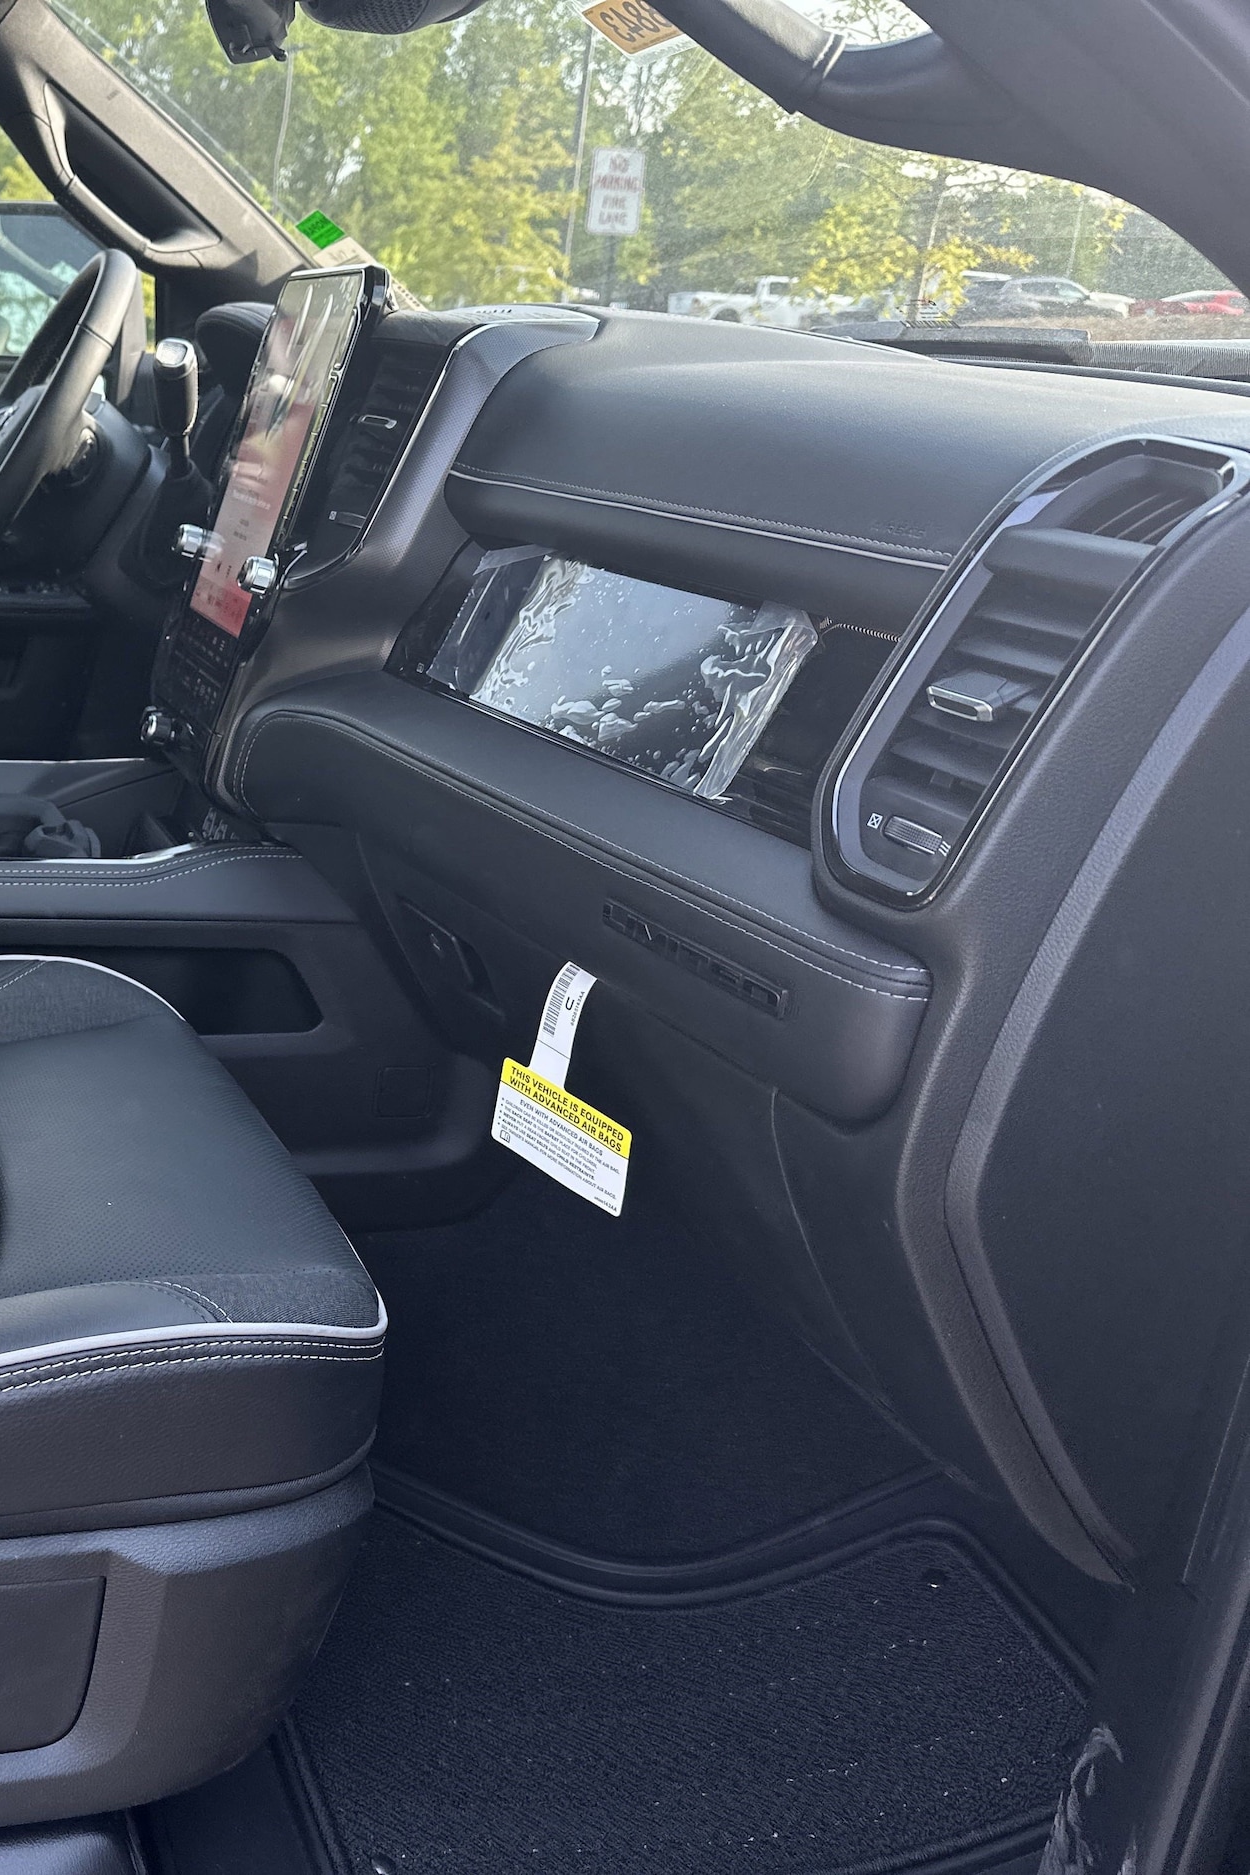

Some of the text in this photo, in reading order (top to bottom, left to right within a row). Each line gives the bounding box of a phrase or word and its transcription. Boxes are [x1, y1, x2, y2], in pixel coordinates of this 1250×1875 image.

[610, 154, 630, 173] NO
[565, 996, 575, 1011] U
[509, 1075, 621, 1152] WITH ADVANCED AIR BAGS
[510, 1065, 624, 1142] THIS VEHICLE IS EQUIPPED
[519, 1098, 602, 1156] EVEN WITH ADVANCED AIR BAGS
